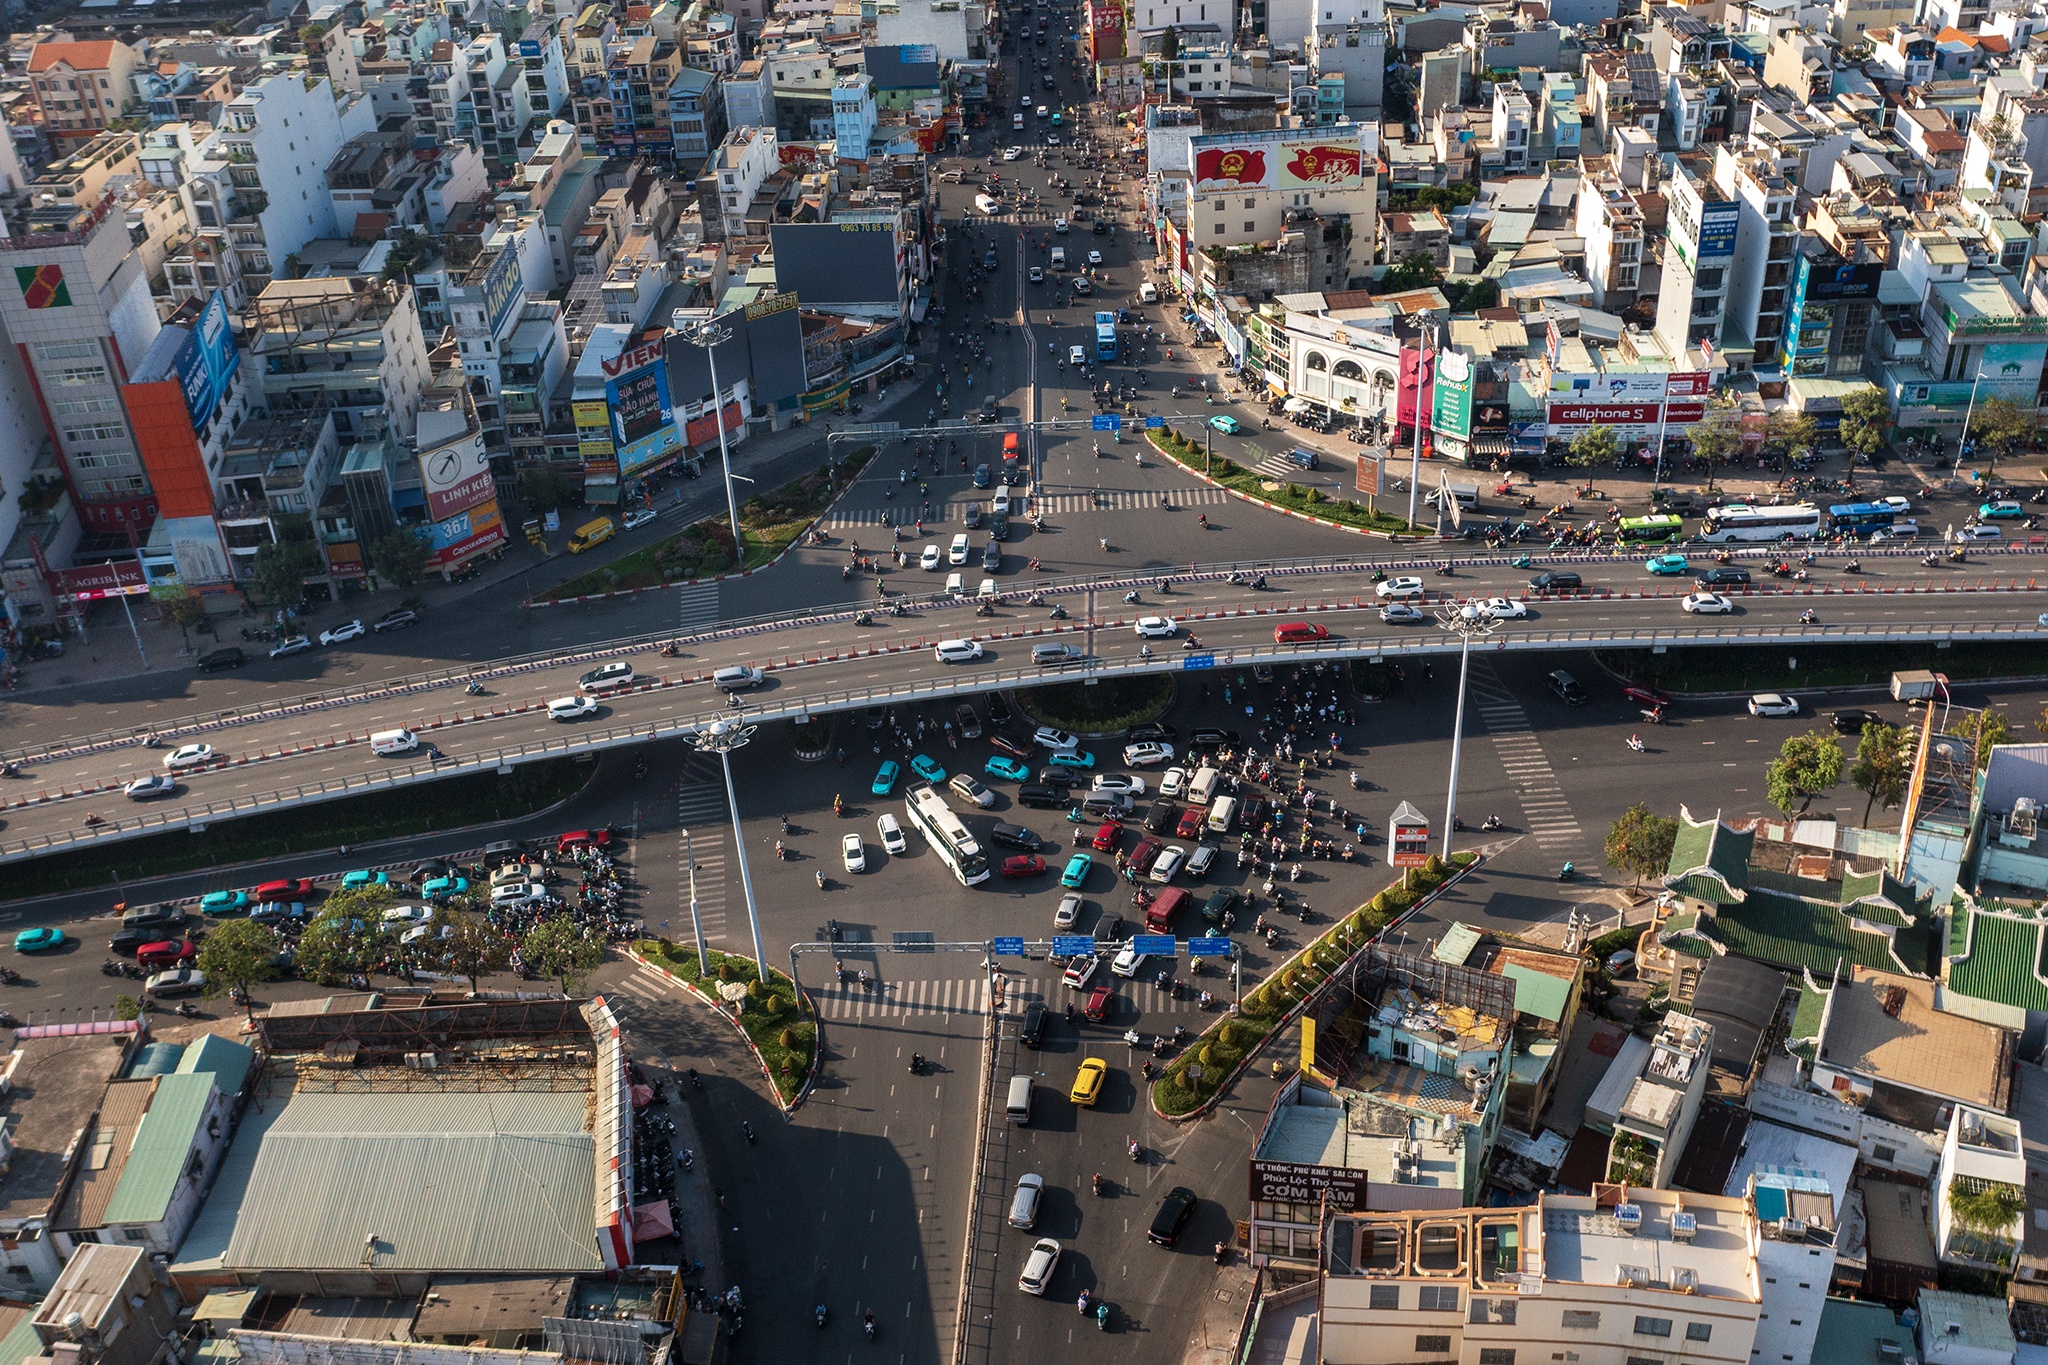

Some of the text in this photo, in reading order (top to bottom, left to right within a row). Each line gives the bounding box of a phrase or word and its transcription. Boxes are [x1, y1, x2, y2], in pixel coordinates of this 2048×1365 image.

[840, 223, 893, 232] 0903 70 85 96
[487, 261, 520, 325] Aikido
[1842, 284, 1869, 292] GROUP
[601, 342, 662, 376] VIỆN
[618, 374, 656, 400] SỬA CHỮA
[638, 389, 660, 407] HÀNH
[660, 408, 672, 420] 26
[1562, 407, 1644, 420] cellphone S
[442, 485, 471, 504] LINH
[442, 515, 469, 539] 367
[75, 572, 140, 588] AGRIBANK
[1263, 1173, 1288, 1184] Phúc
[1289, 1175, 1308, 1186] Lộc
[1262, 1184, 1356, 1203] CƠM TẤM
